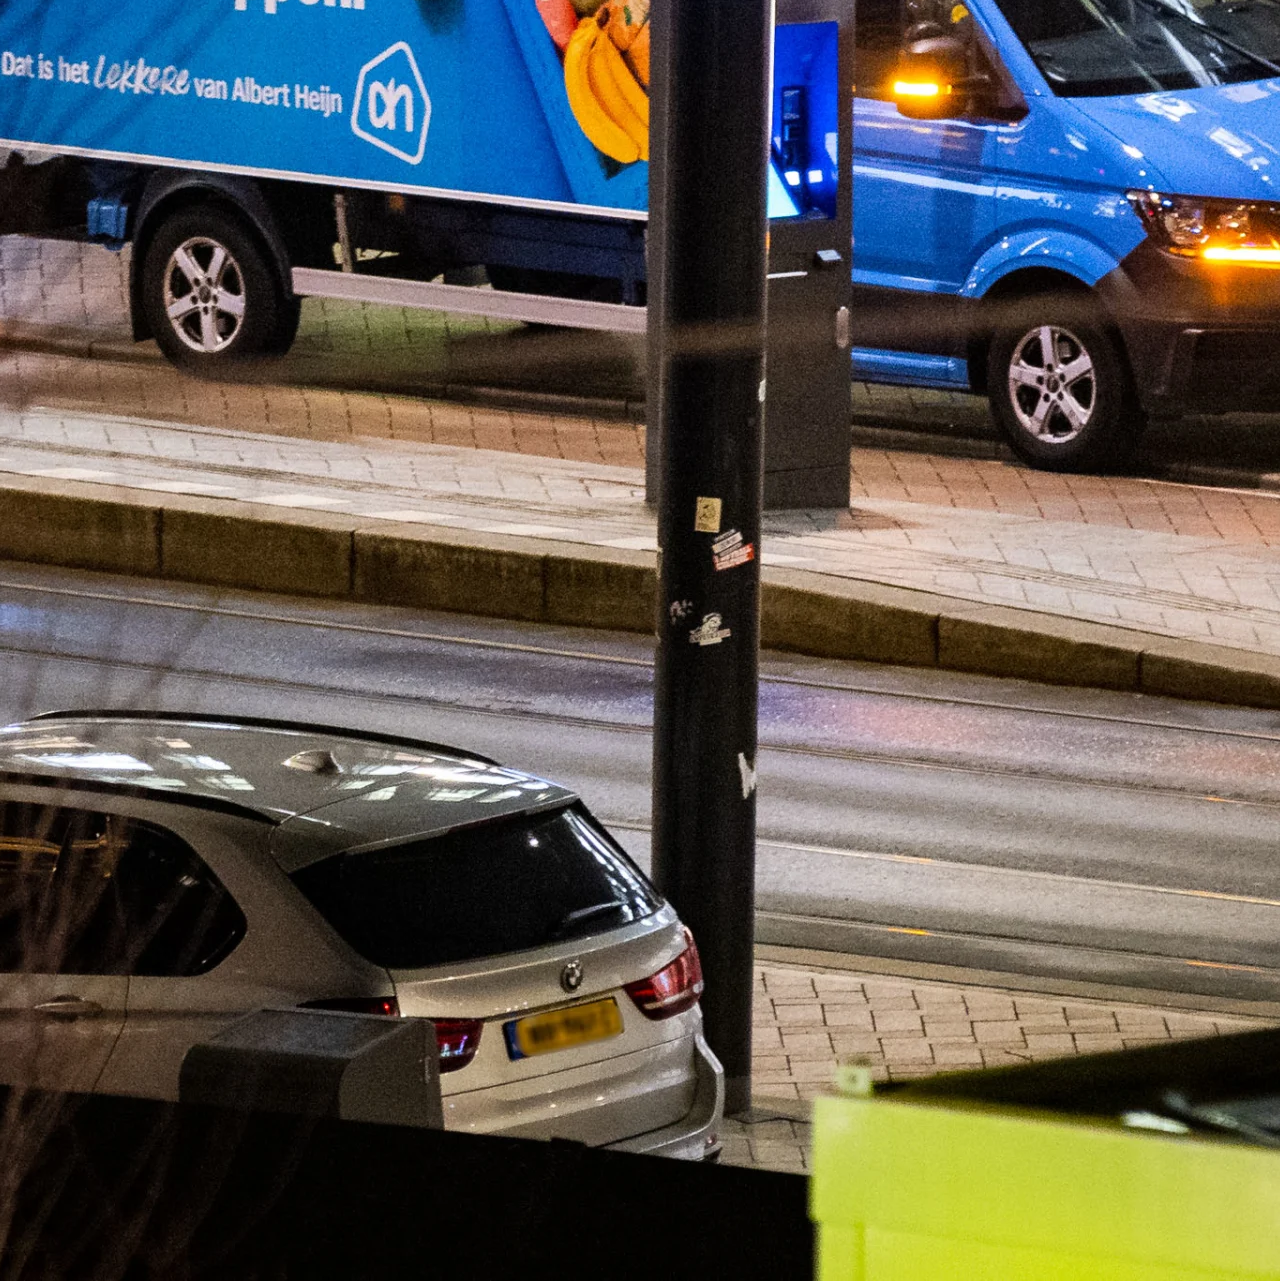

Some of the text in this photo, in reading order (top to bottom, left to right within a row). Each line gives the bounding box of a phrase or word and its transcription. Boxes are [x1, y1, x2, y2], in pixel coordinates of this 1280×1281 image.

[1, 51, 35, 78] Dat
[37, 52, 54, 80] is
[58, 55, 90, 85] het
[193, 77, 228, 101] van
[232, 76, 291, 108] Albert
[294, 83, 344, 117] Heijn
